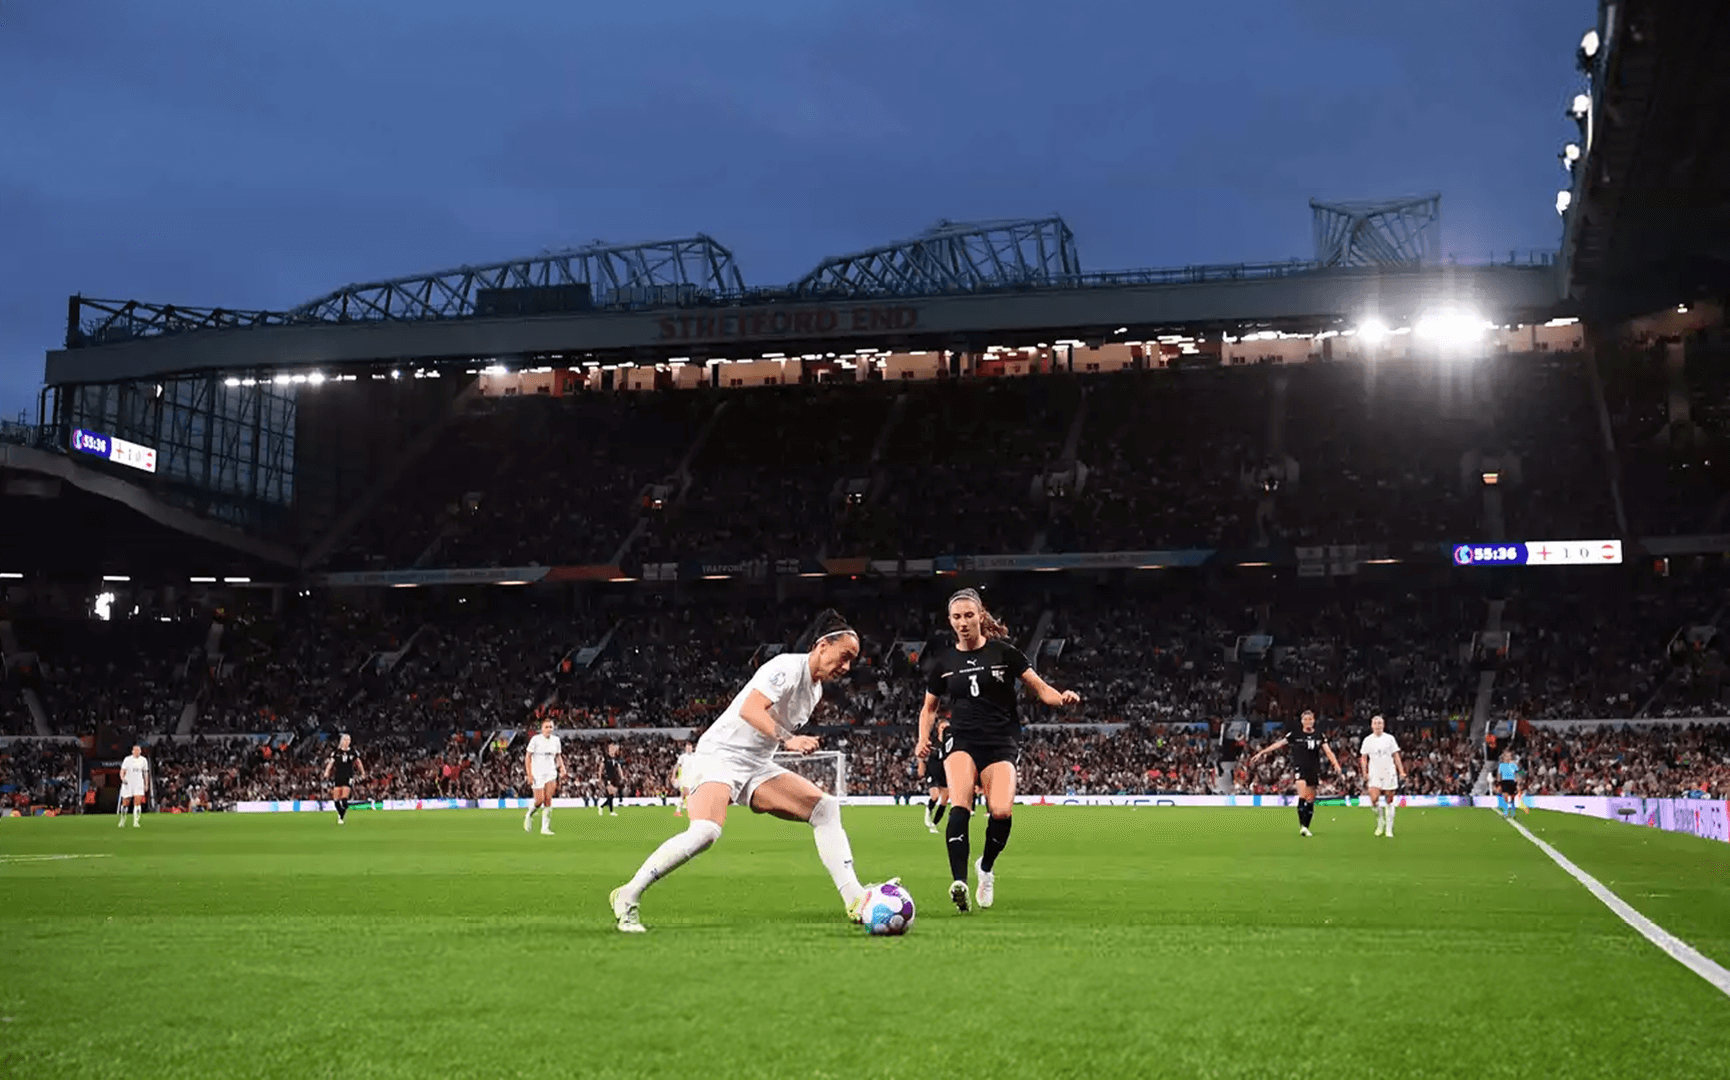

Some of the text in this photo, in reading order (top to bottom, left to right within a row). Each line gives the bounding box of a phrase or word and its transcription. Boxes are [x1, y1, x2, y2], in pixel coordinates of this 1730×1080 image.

[659, 306, 917, 340] STRETFORD END
[1473, 547, 1517, 561] 55:36
[1579, 547, 1589, 559] 0
[968, 674, 980, 697] 3
